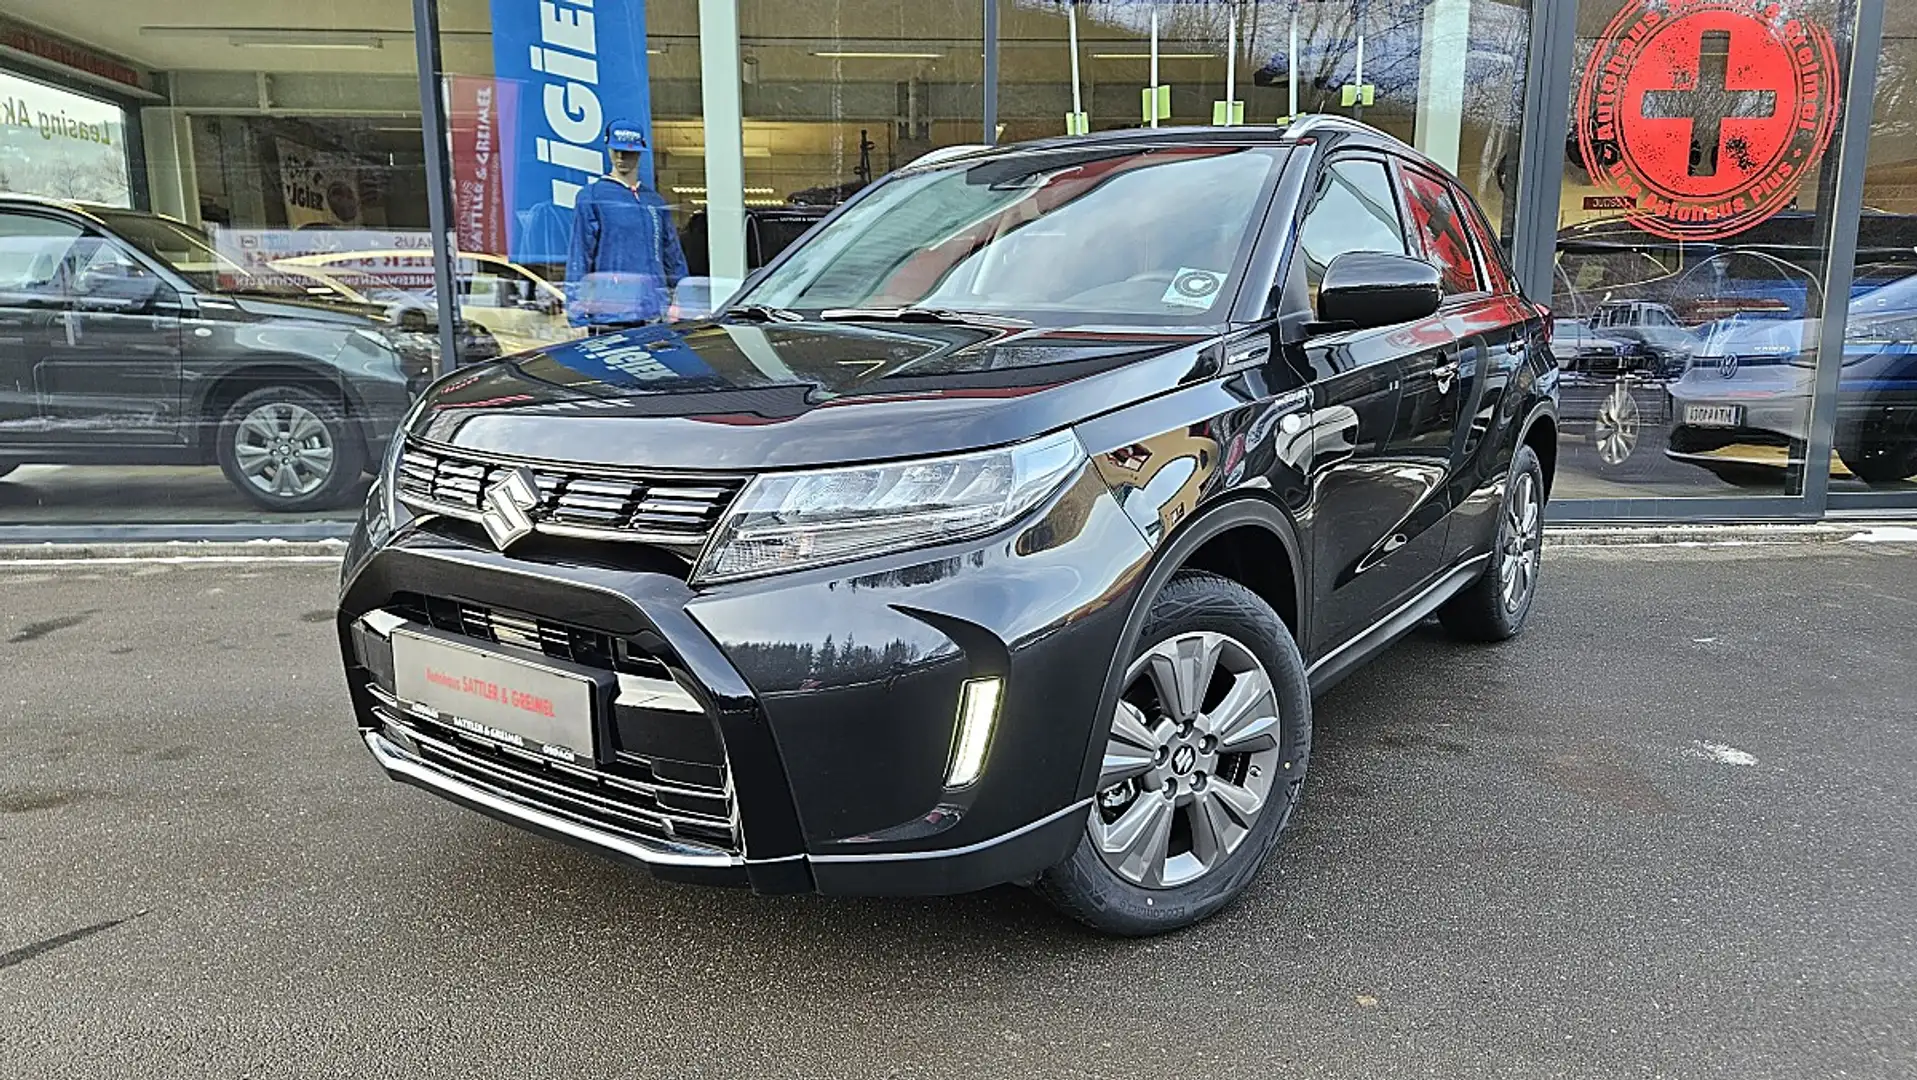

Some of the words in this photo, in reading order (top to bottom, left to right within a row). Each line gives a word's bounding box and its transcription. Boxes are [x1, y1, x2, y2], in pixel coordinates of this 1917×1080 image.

[1597, 12, 1660, 140] Autohaus
[475, 86, 492, 165] GREIMEL
[474, 167, 488, 181] &
[1608, 160, 1643, 198] Das
[1642, 192, 1747, 222] Autohaus
[1749, 161, 1794, 204] Plus
[469, 182, 485, 252] SATTLER
[462, 676, 499, 702] SATTLER
[500, 687, 508, 704] &
[510, 689, 556, 717] GREIMEL
